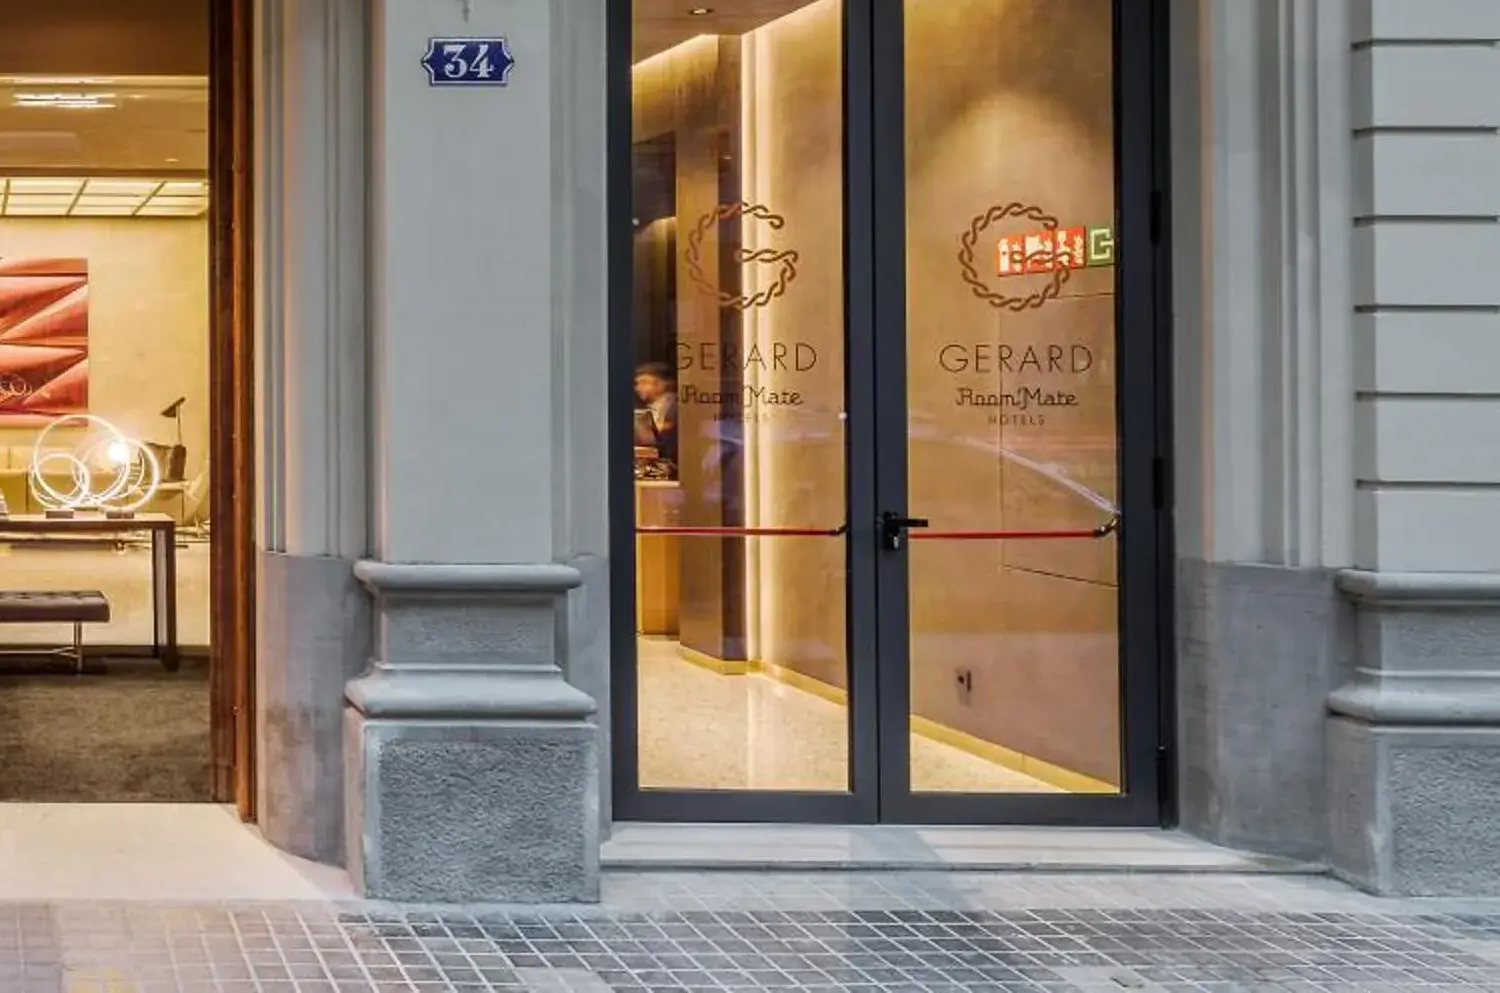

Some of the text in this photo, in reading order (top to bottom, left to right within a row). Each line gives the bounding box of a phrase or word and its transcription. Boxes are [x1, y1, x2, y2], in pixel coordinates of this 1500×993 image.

[442, 43, 495, 79] 34
[665, 341, 818, 372] GERARD
[939, 343, 1094, 374] GERARD
[987, 414, 1046, 426] HOTELS
